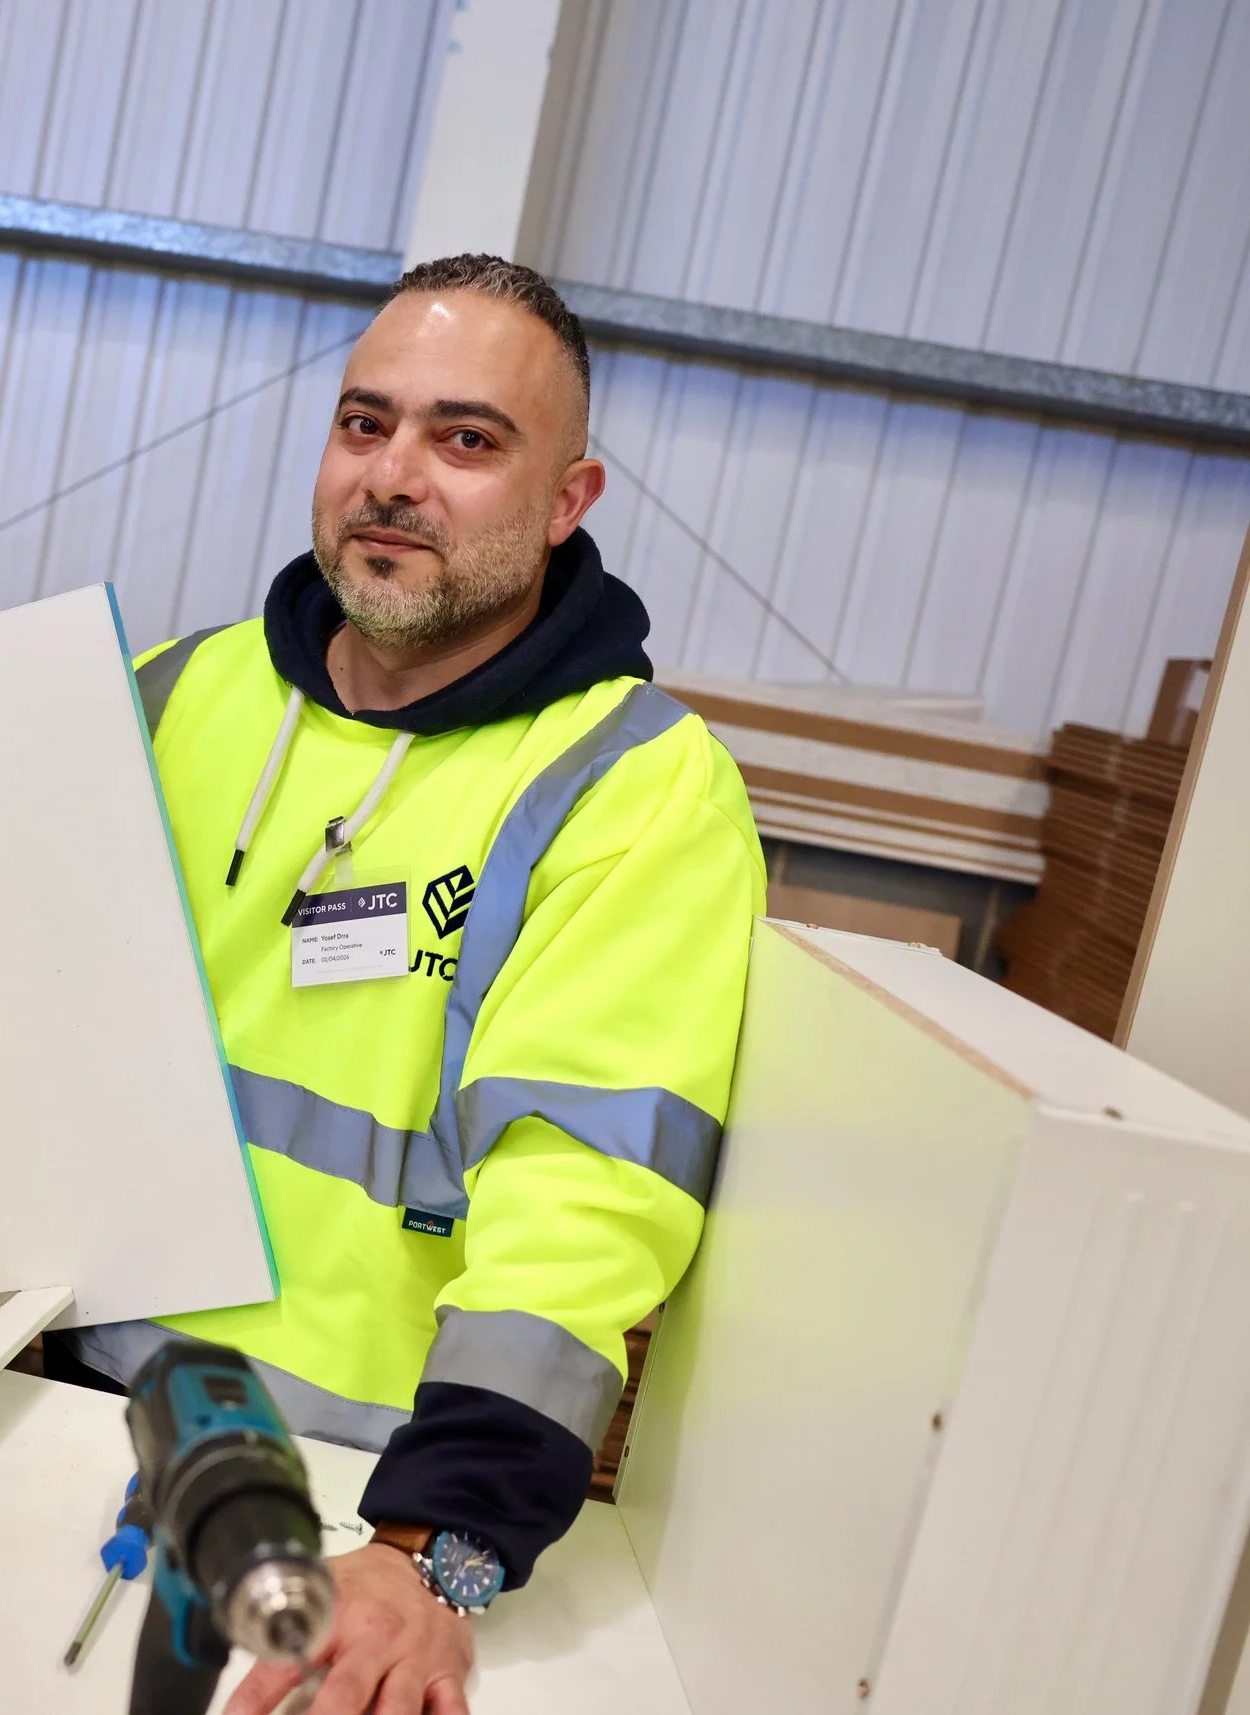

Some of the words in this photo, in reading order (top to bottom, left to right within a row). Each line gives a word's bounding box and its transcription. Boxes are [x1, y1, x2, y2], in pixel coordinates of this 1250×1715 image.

[298, 905, 327, 916] VISITOR
[327, 903, 347, 912] PASS
[368, 892, 398, 911] JTC
[408, 950, 458, 981] JTC
[409, 1220, 447, 1234] PORTWEST
